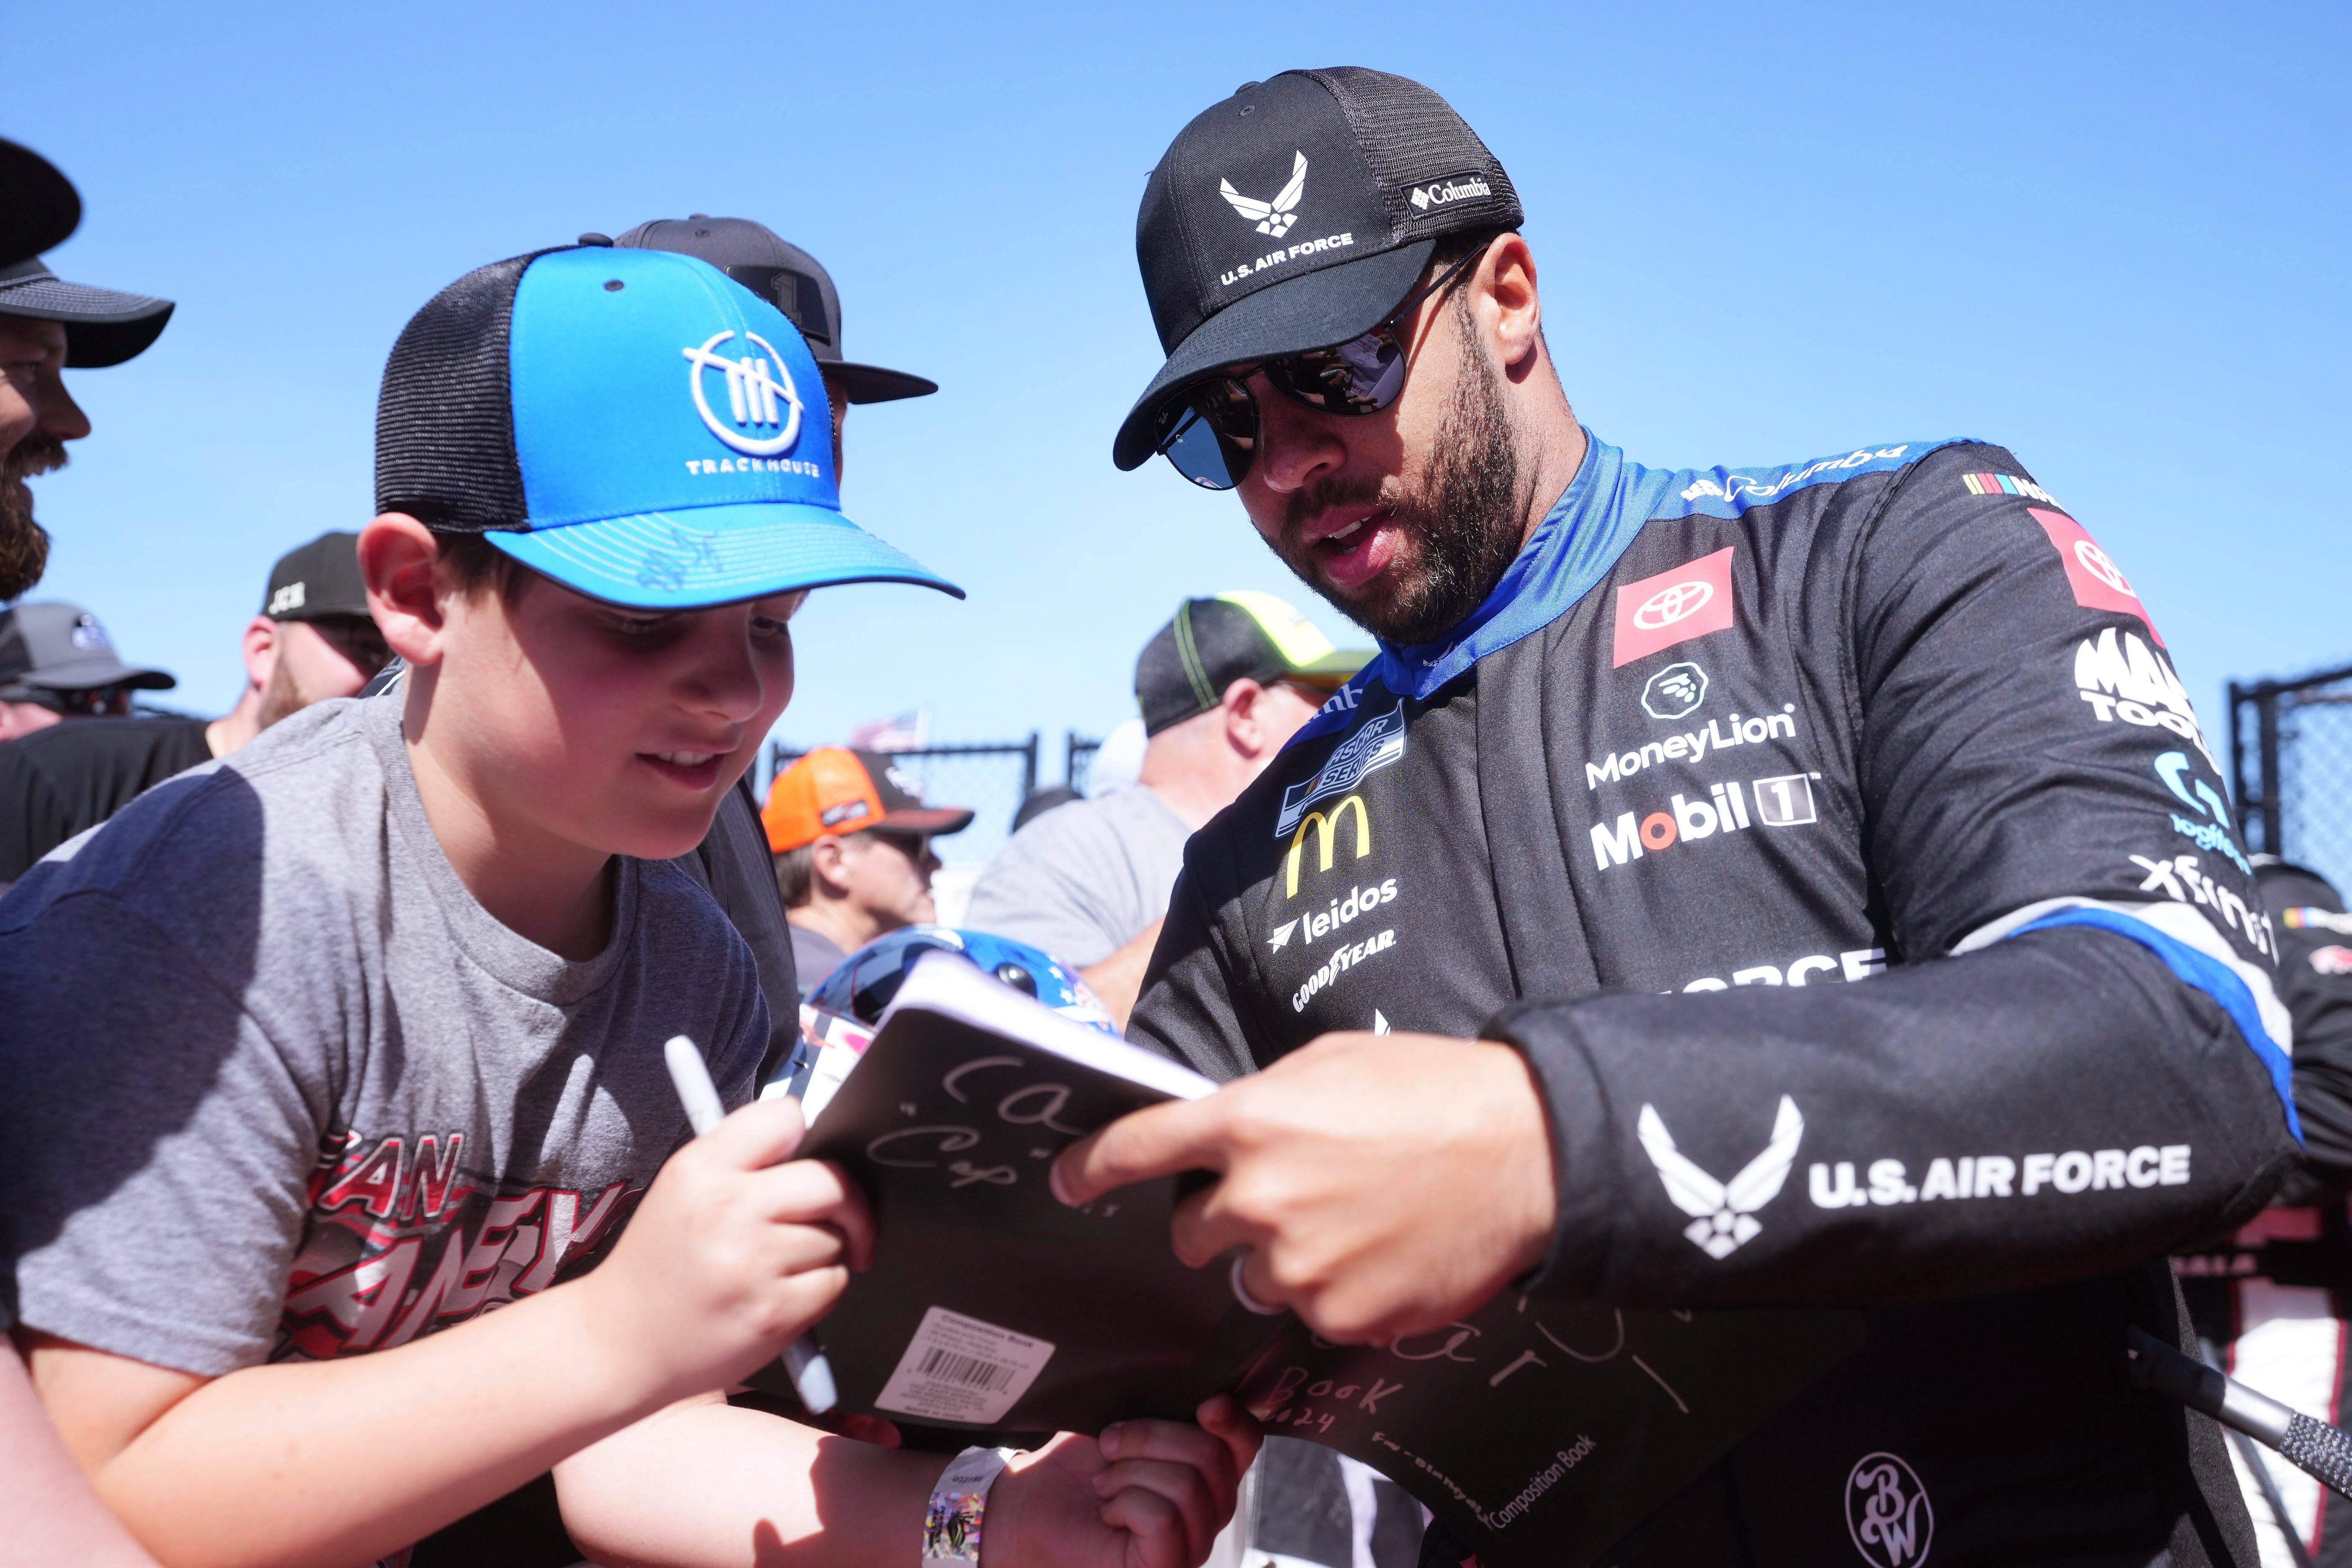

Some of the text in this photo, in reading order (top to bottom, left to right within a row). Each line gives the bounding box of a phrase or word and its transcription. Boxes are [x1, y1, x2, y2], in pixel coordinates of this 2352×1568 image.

[1428, 177, 1491, 205] Columbia
[1220, 232, 1354, 286] U.S. AIR FORCE
[685, 457, 820, 478] TRACKHOUSE
[1322, 739, 1385, 786] SERIES
[1590, 781, 1751, 871] Mobil
[1303, 879, 1398, 945] leidos
[1808, 1144, 2192, 1209] U.S. AIR FORCE
[1489, 1462, 1566, 1529] Composition
[1556, 1433, 1597, 1469] Book
